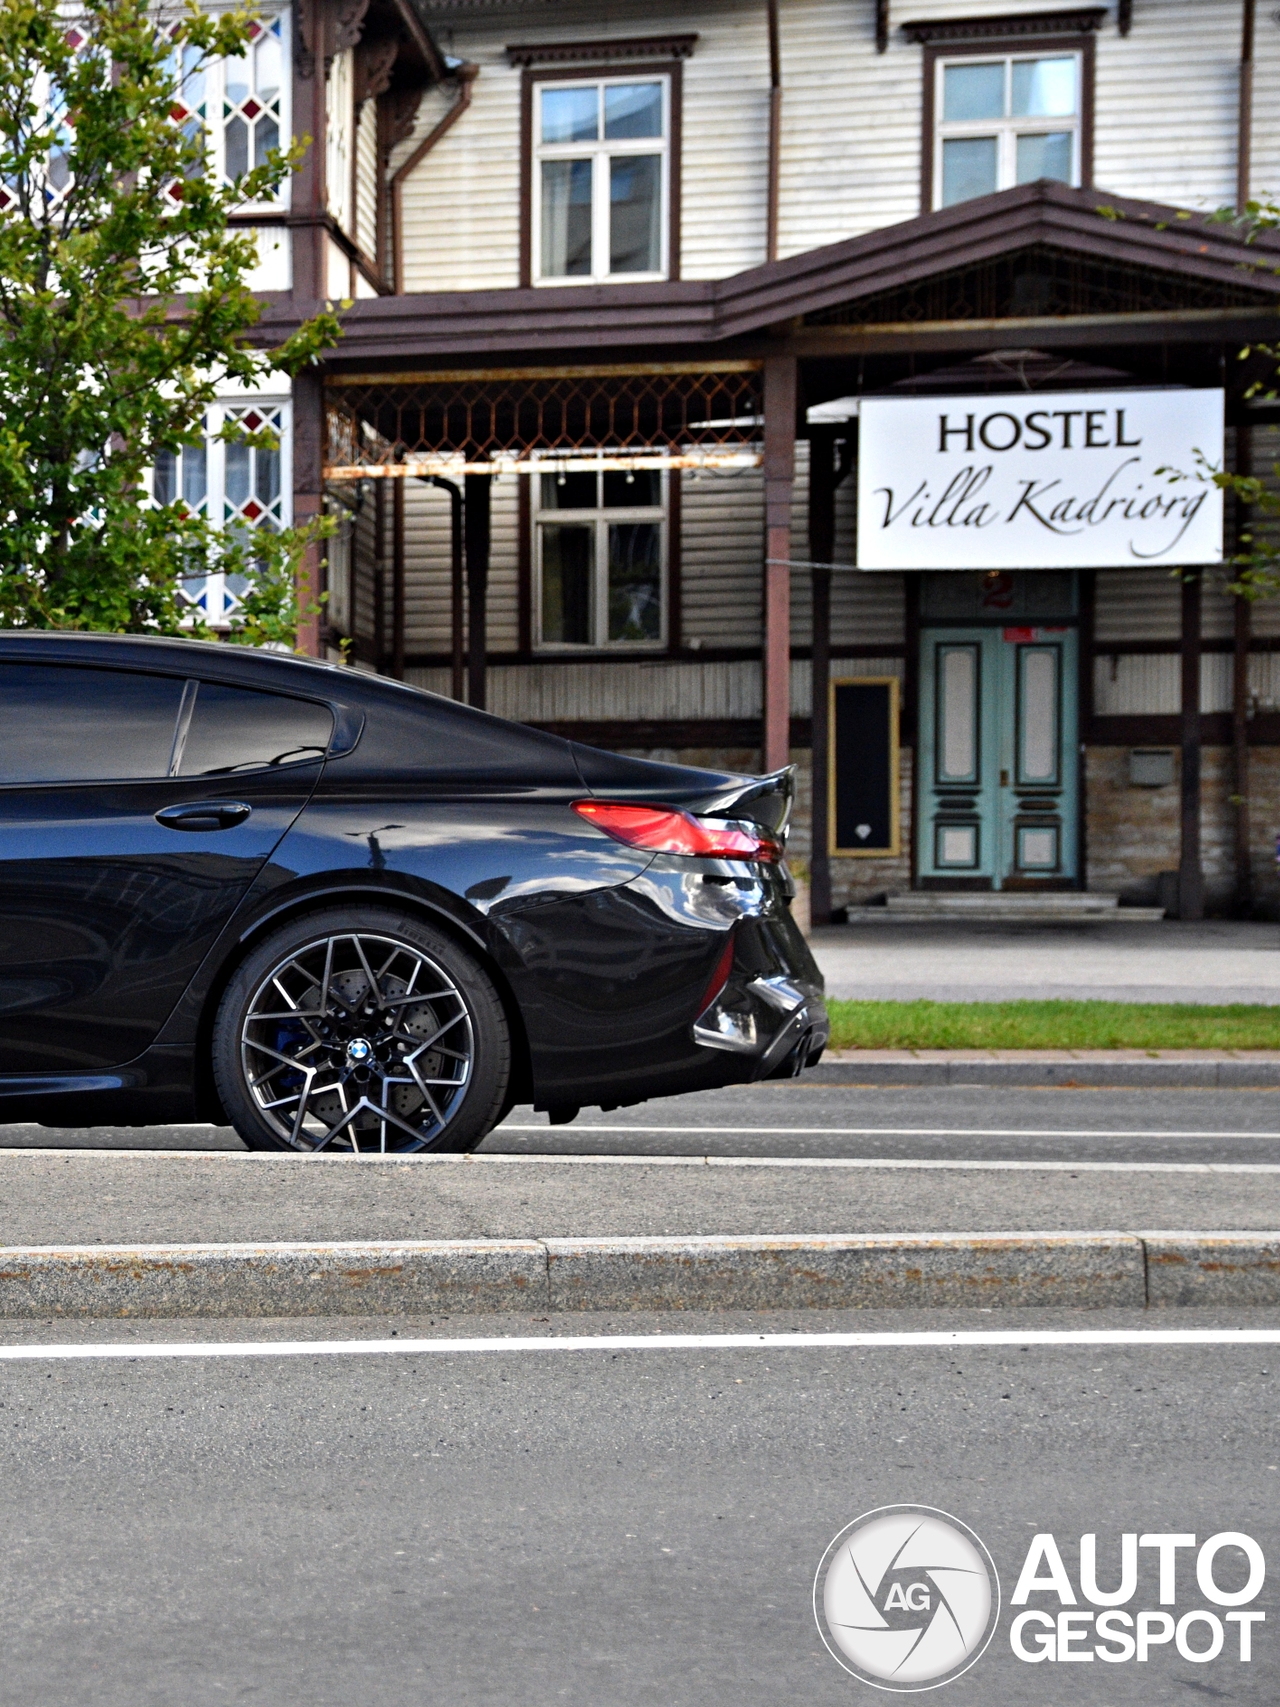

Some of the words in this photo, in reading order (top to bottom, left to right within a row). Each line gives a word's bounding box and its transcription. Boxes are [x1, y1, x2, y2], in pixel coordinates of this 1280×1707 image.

[937, 408, 1141, 453] HOSTEL
[872, 464, 999, 529] Villa
[1005, 456, 1208, 558] Kadriorg
